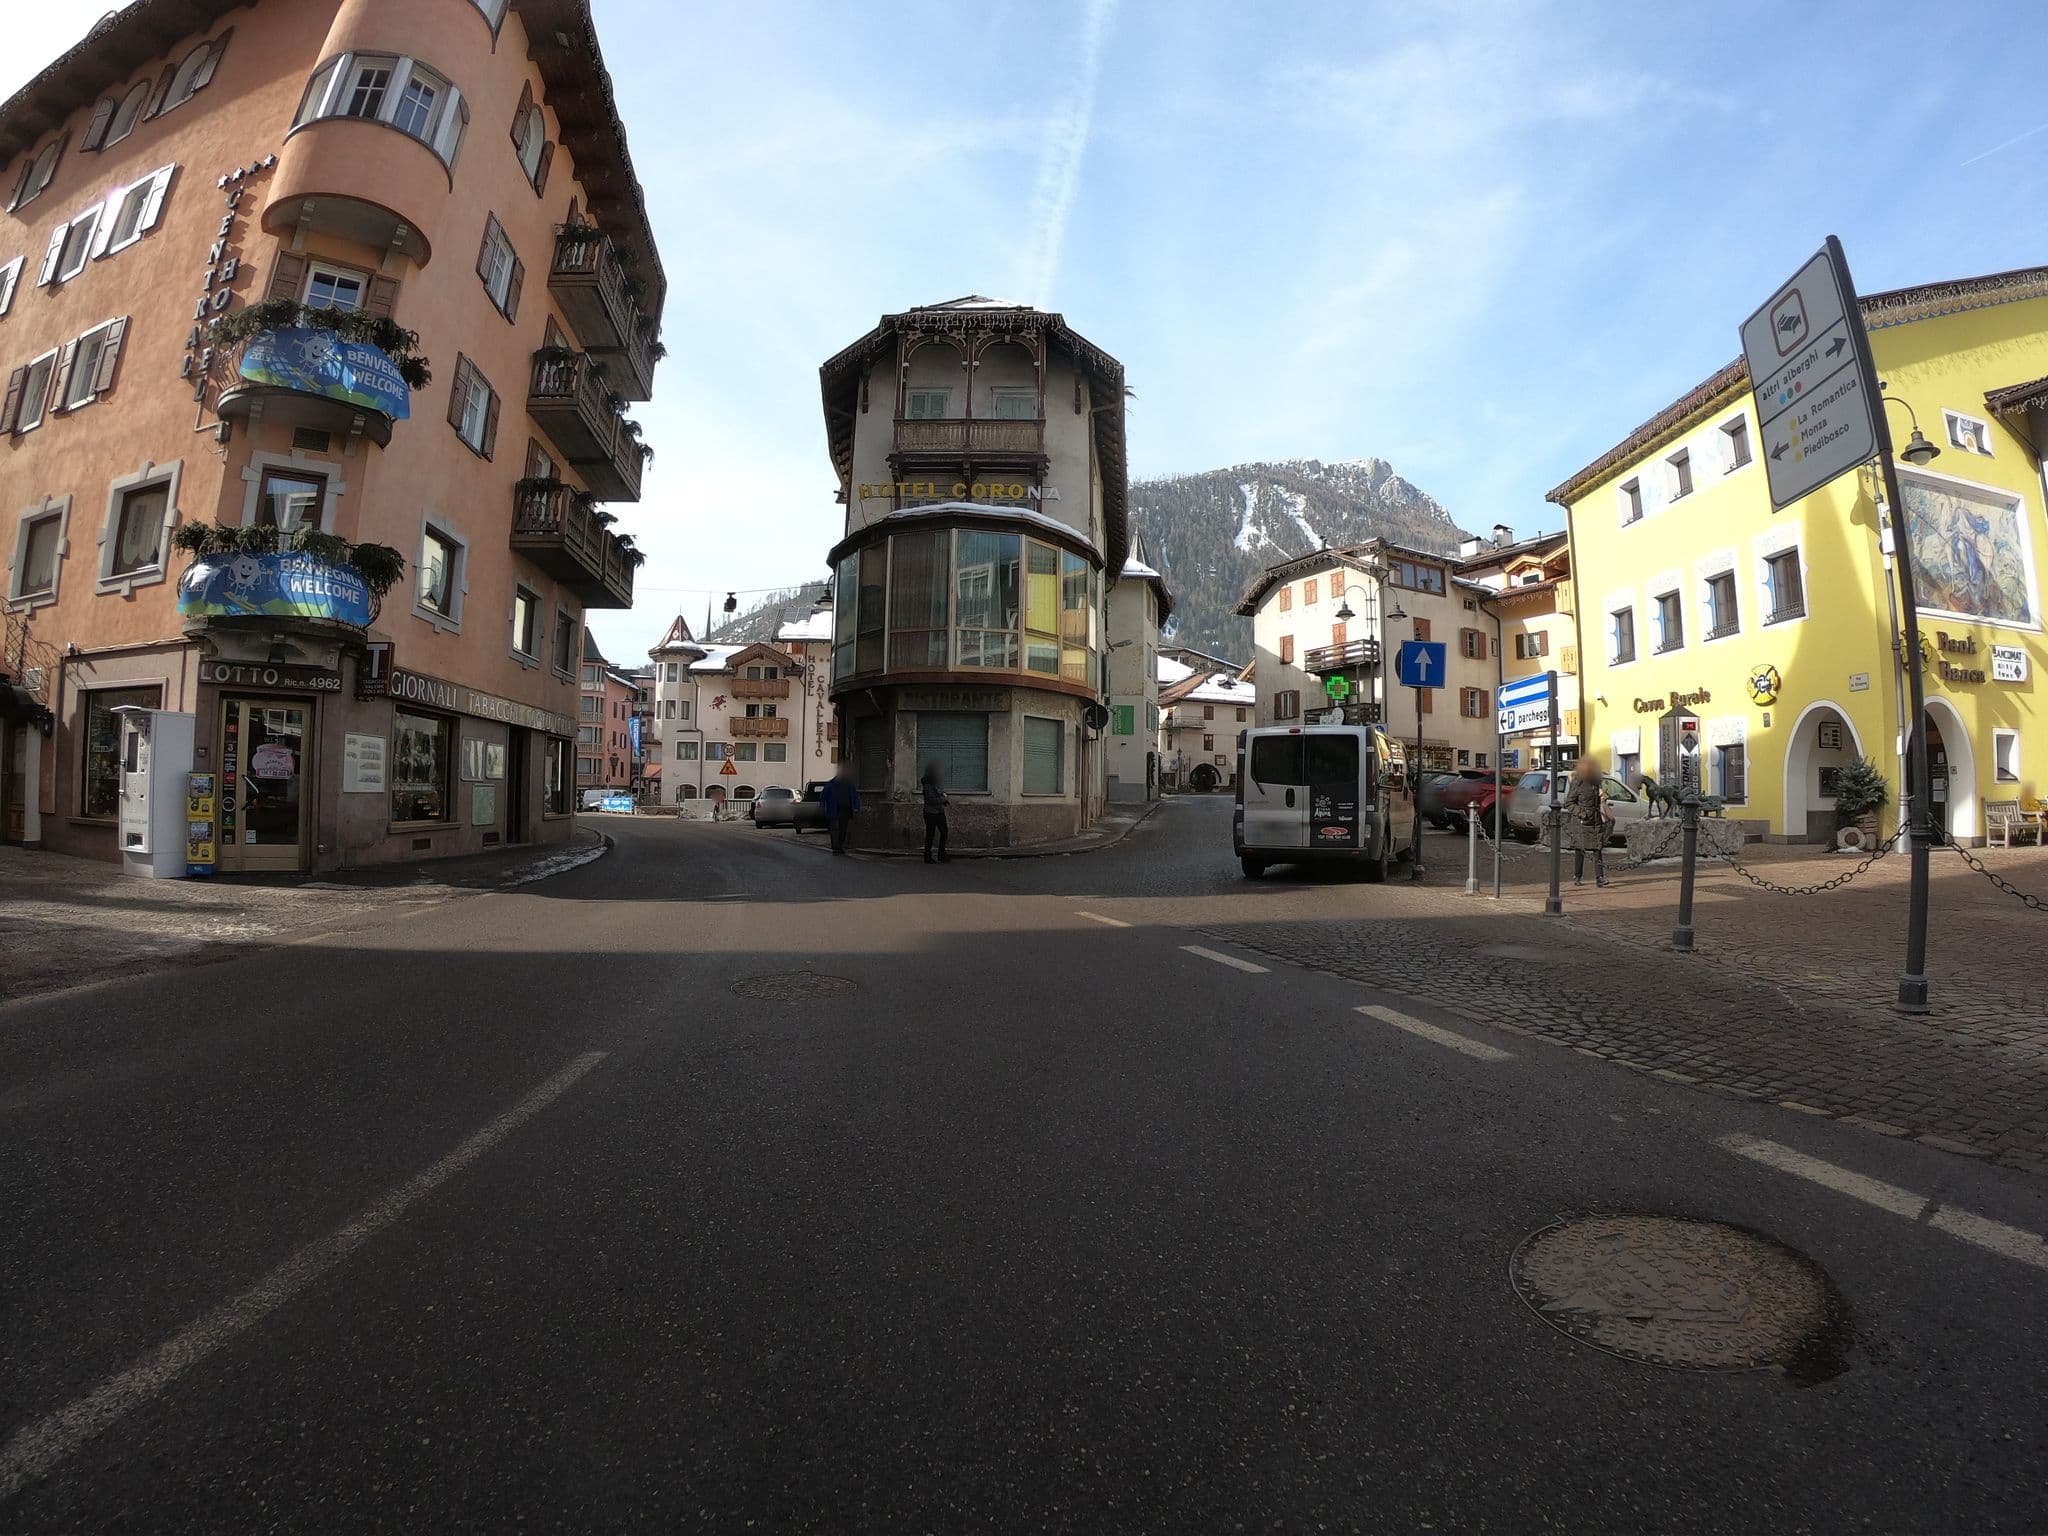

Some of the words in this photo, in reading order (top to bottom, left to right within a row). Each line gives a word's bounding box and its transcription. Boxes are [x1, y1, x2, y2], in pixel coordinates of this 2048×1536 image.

[180, 187, 243, 378] CENTRAL
[352, 368, 405, 401] WELCOME
[1762, 379, 1780, 401] altri
[1783, 349, 1819, 386] alberghi
[1797, 410, 1809, 425] La
[1811, 378, 1857, 416] Romantica
[1800, 418, 1828, 441] Monza
[1803, 422, 1850, 457] Piedibosco
[858, 482, 941, 500] HOTEL
[952, 482, 1061, 501] CORONA
[290, 578, 360, 605] WELCOME
[1936, 631, 1977, 655] Bank
[199, 663, 279, 685] LOTTO
[309, 677, 341, 690] 4962
[367, 644, 389, 679] T
[807, 656, 816, 697] HOTEL
[1940, 660, 1986, 684] Banca
[391, 671, 457, 708] GIORNALI
[468, 693, 521, 723] TABACCHI
[815, 675, 825, 758] CAVALLETTO
